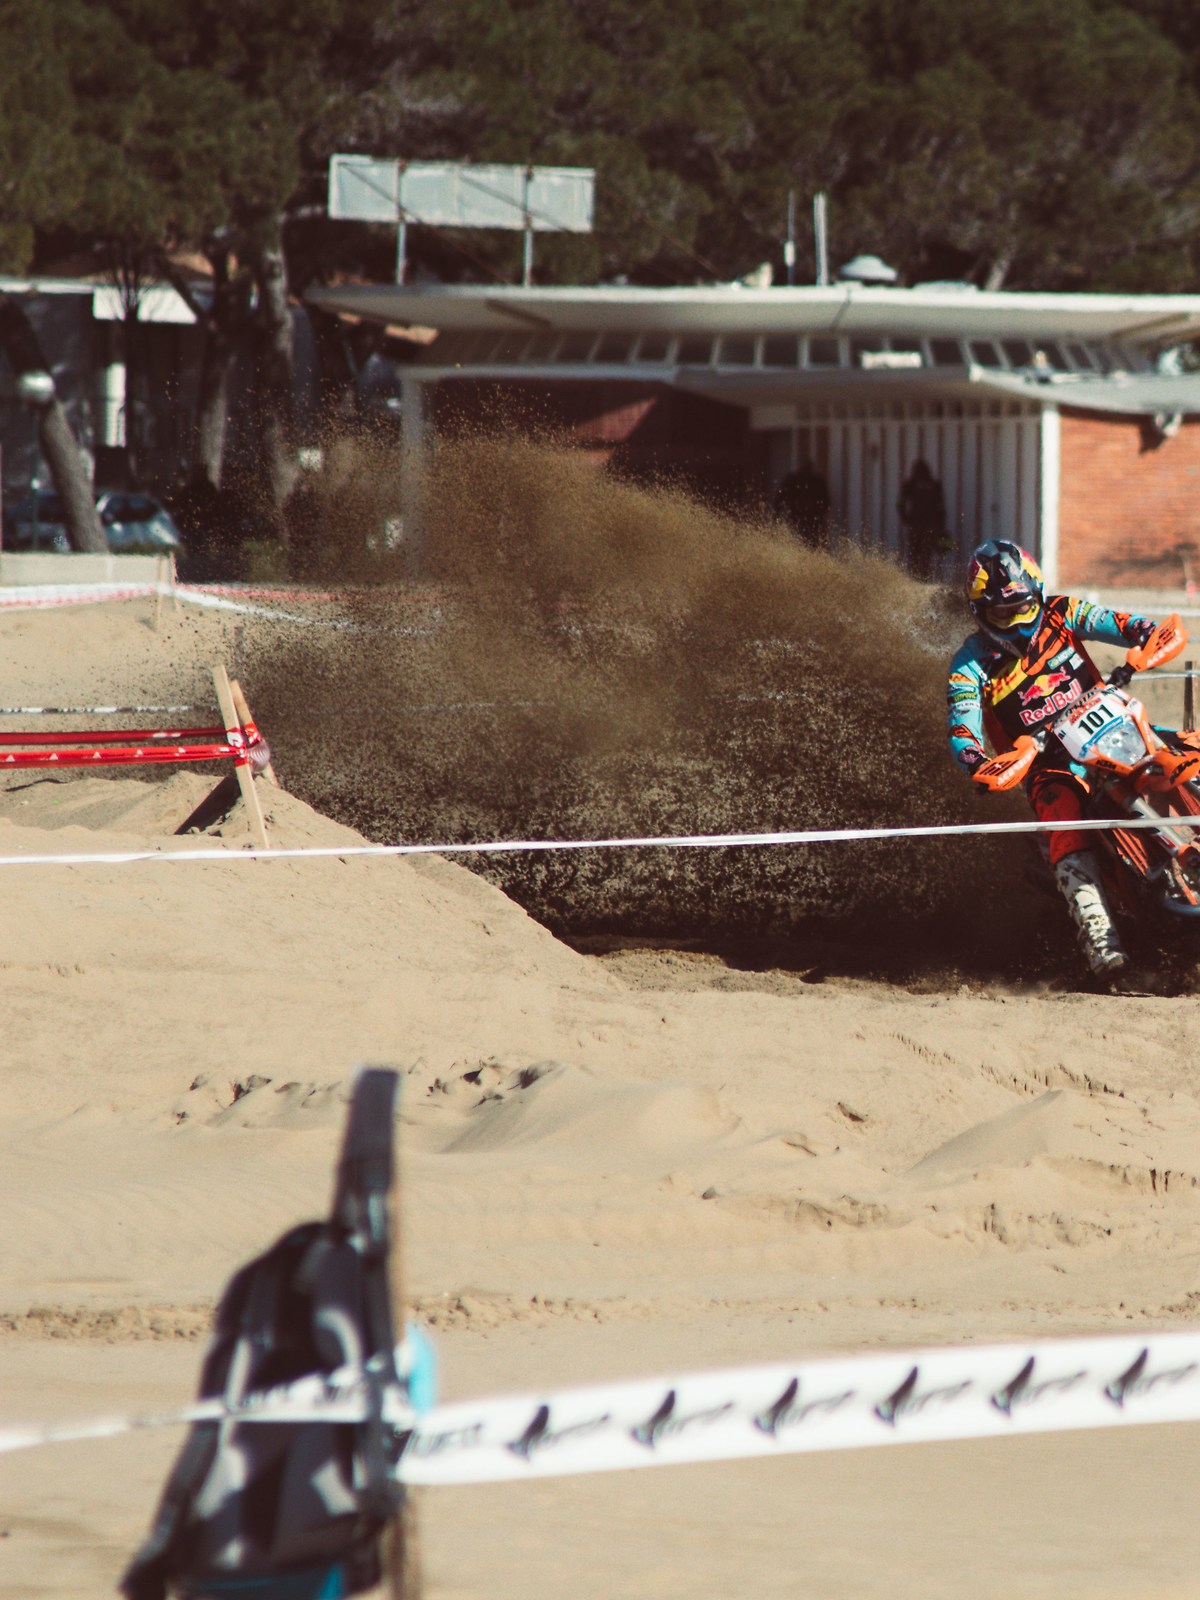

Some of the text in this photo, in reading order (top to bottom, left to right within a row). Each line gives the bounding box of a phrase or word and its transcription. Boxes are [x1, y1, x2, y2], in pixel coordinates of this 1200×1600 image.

[1019, 696, 1057, 726] Red
[1051, 678, 1082, 710] Bull
[1078, 704, 1114, 736] 101
